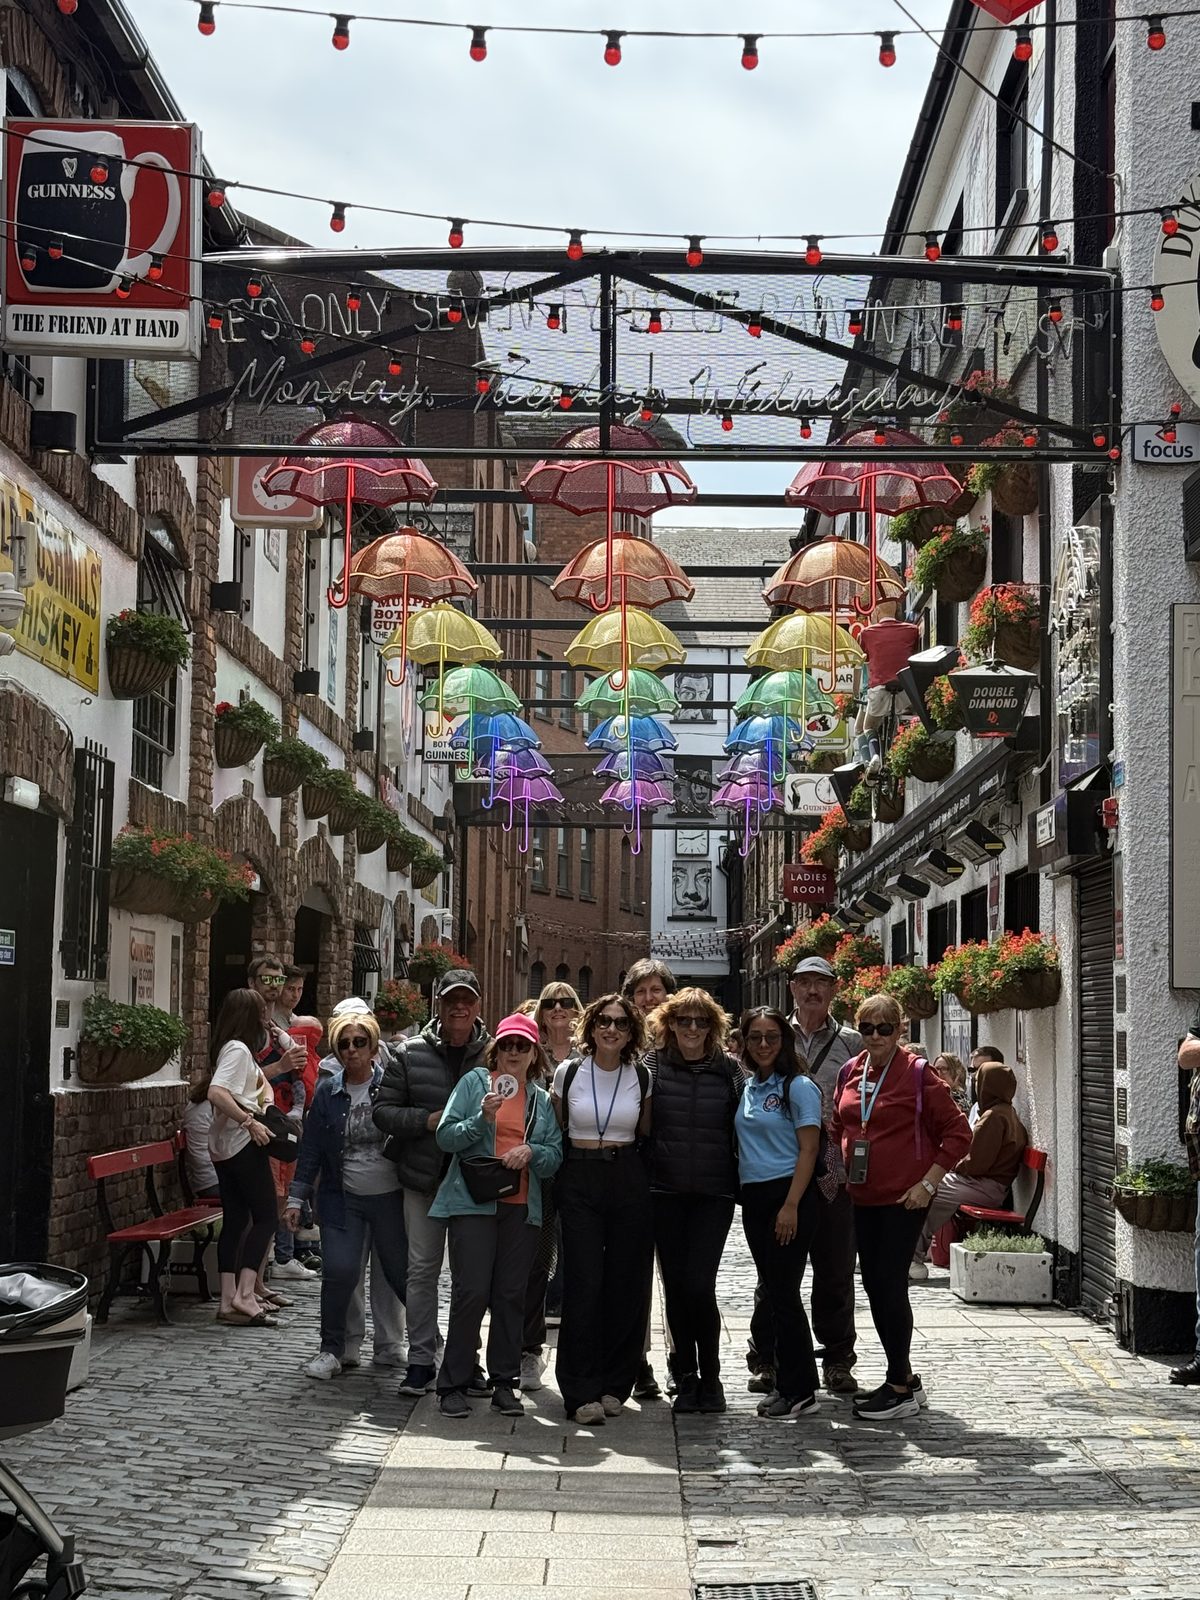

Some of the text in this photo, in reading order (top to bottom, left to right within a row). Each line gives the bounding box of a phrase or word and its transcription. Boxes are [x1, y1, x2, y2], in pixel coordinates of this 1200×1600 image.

[27, 183, 116, 201] GUINNESS
[301, 291, 391, 335] ONLY
[12, 313, 179, 339] THE FRIEND AT HAND
[1143, 440, 1193, 458] focus
[20, 587, 81, 666] HISKEY
[375, 631, 388, 639] THE
[973, 687, 1015, 697] DOUBLE
[968, 698, 1018, 709] DIAMOND
[790, 873, 827, 881] LADIES
[793, 886, 825, 894] ROOM
